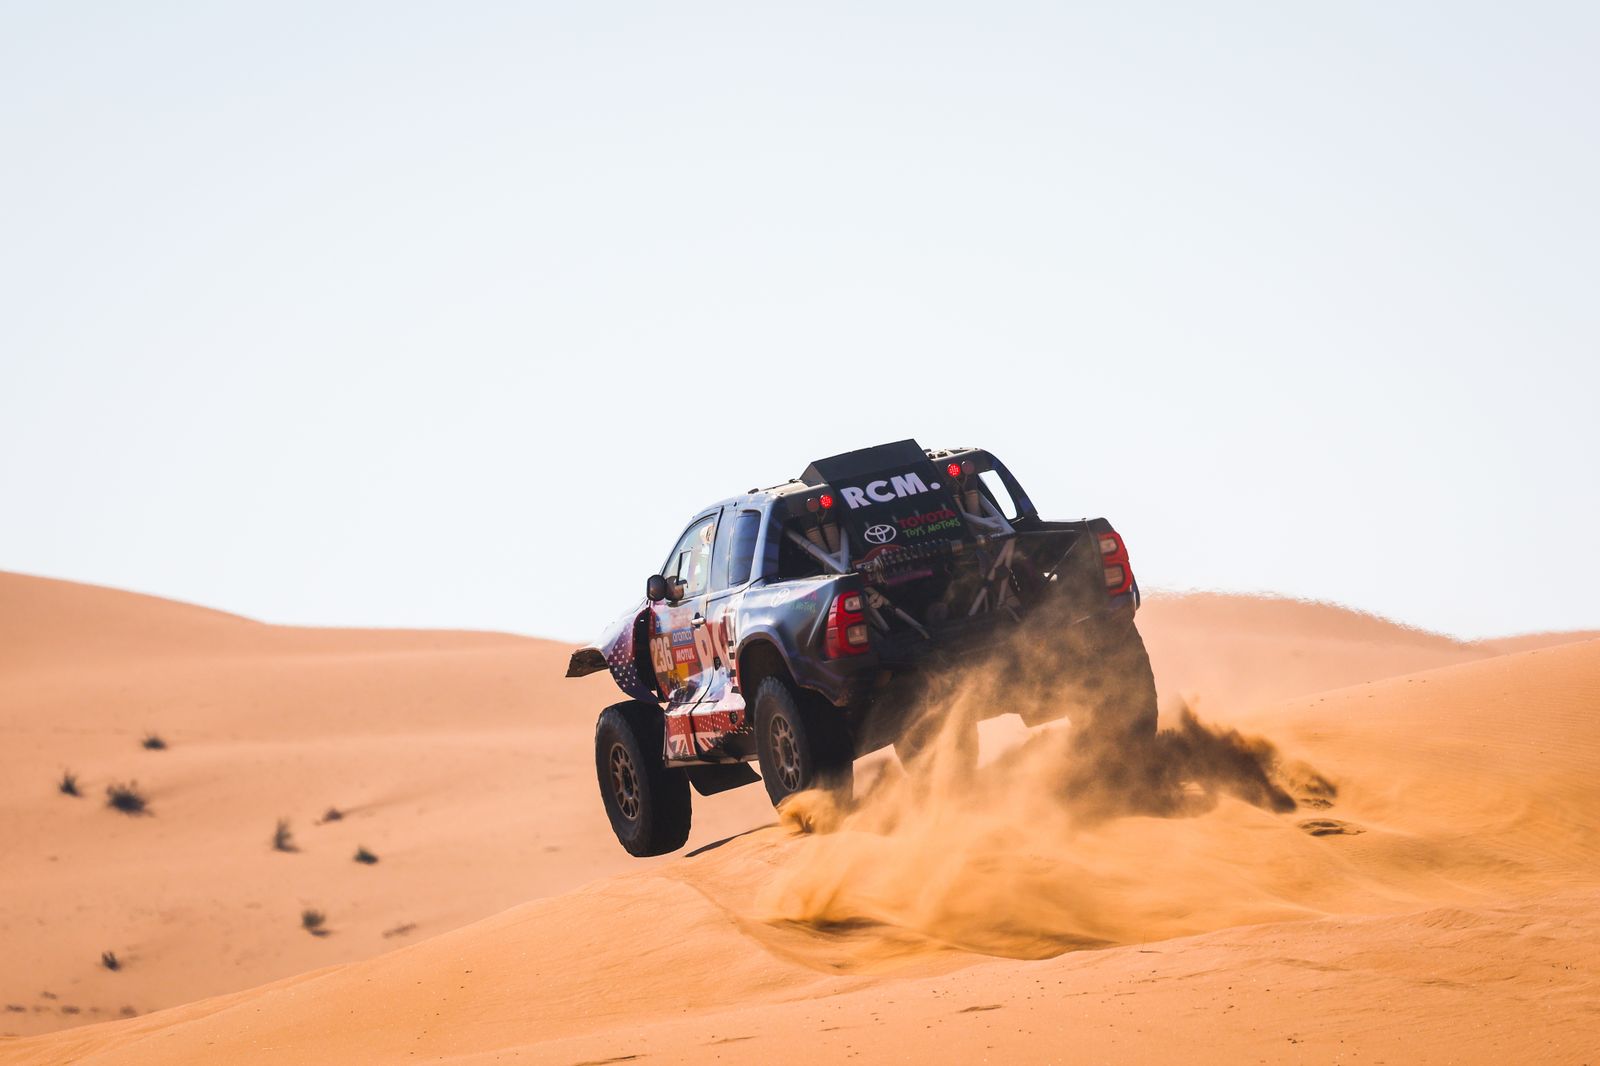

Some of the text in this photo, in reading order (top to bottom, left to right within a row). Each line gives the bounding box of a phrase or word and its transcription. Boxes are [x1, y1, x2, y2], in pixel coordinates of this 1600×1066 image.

[840, 472, 940, 509] RCM.
[898, 508, 957, 529] TOYOTA
[902, 518, 961, 539] TOYS MOTORS
[673, 630, 692, 643] aramco
[651, 637, 675, 672] 236
[676, 648, 694, 661] MOTUL
